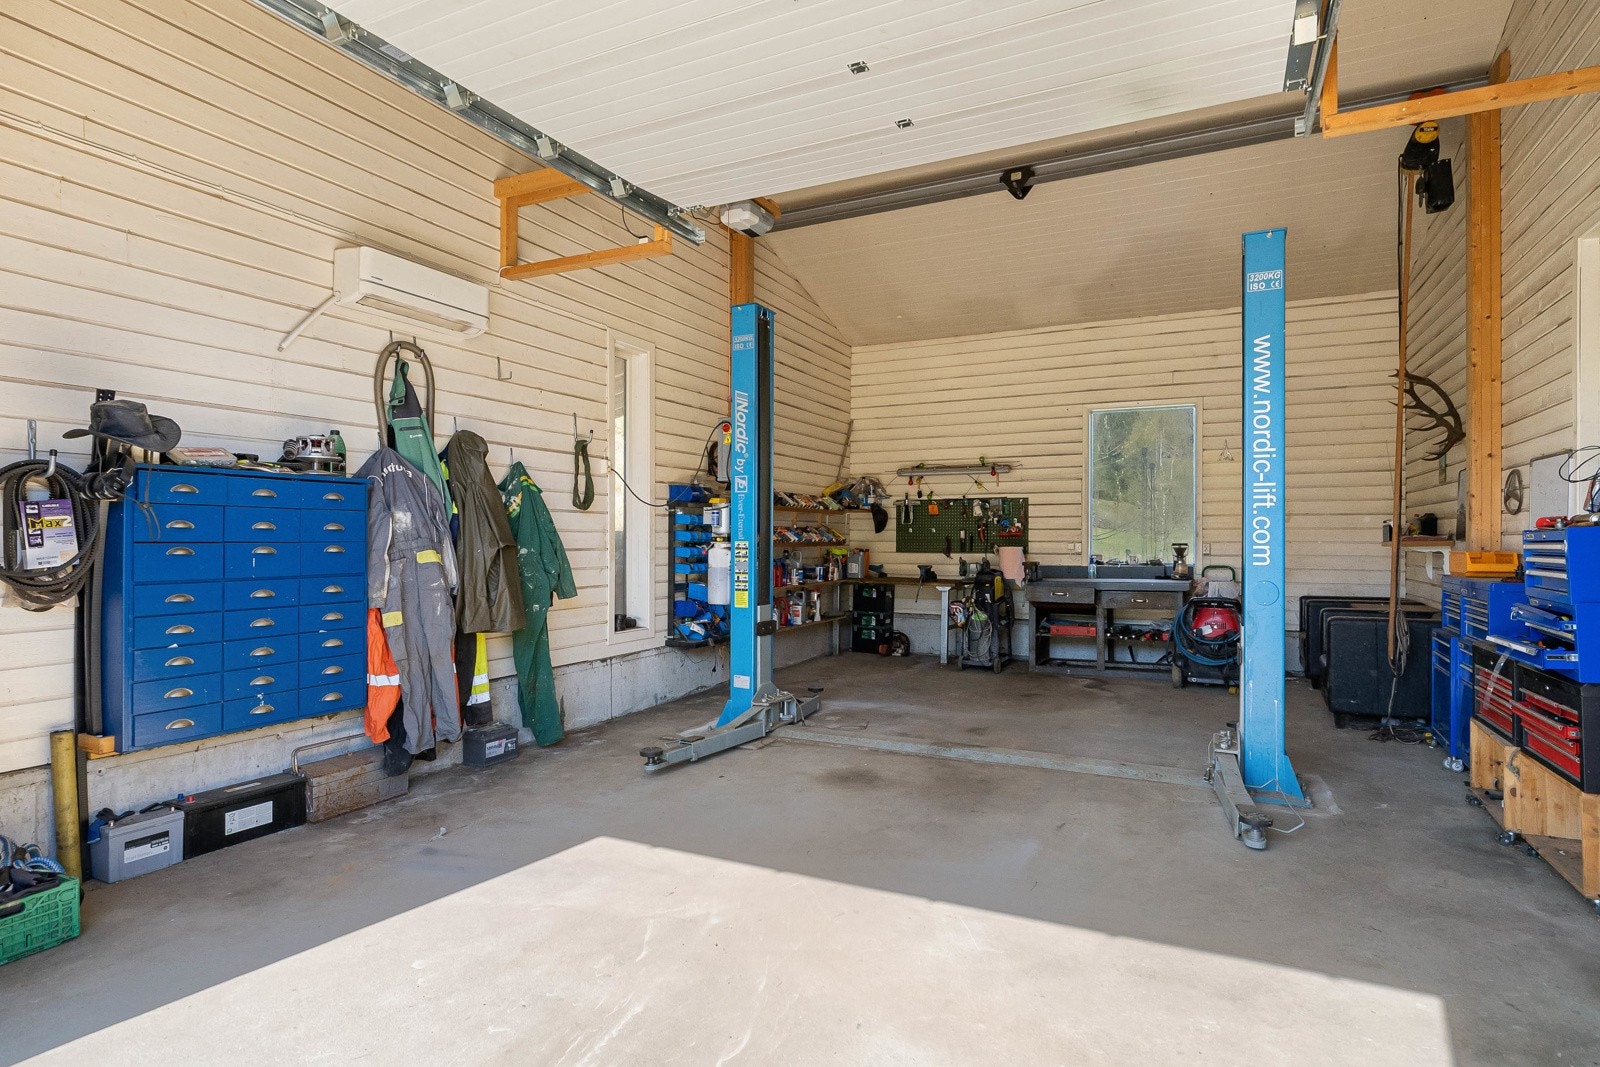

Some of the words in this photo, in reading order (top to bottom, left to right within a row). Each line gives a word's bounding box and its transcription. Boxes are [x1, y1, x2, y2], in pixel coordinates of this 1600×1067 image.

[1249, 271, 1281, 282] 3200KG
[1249, 282, 1266, 290] ISO
[1253, 334, 1277, 566] www.nordic-lift.com
[735, 459, 746, 473] by
